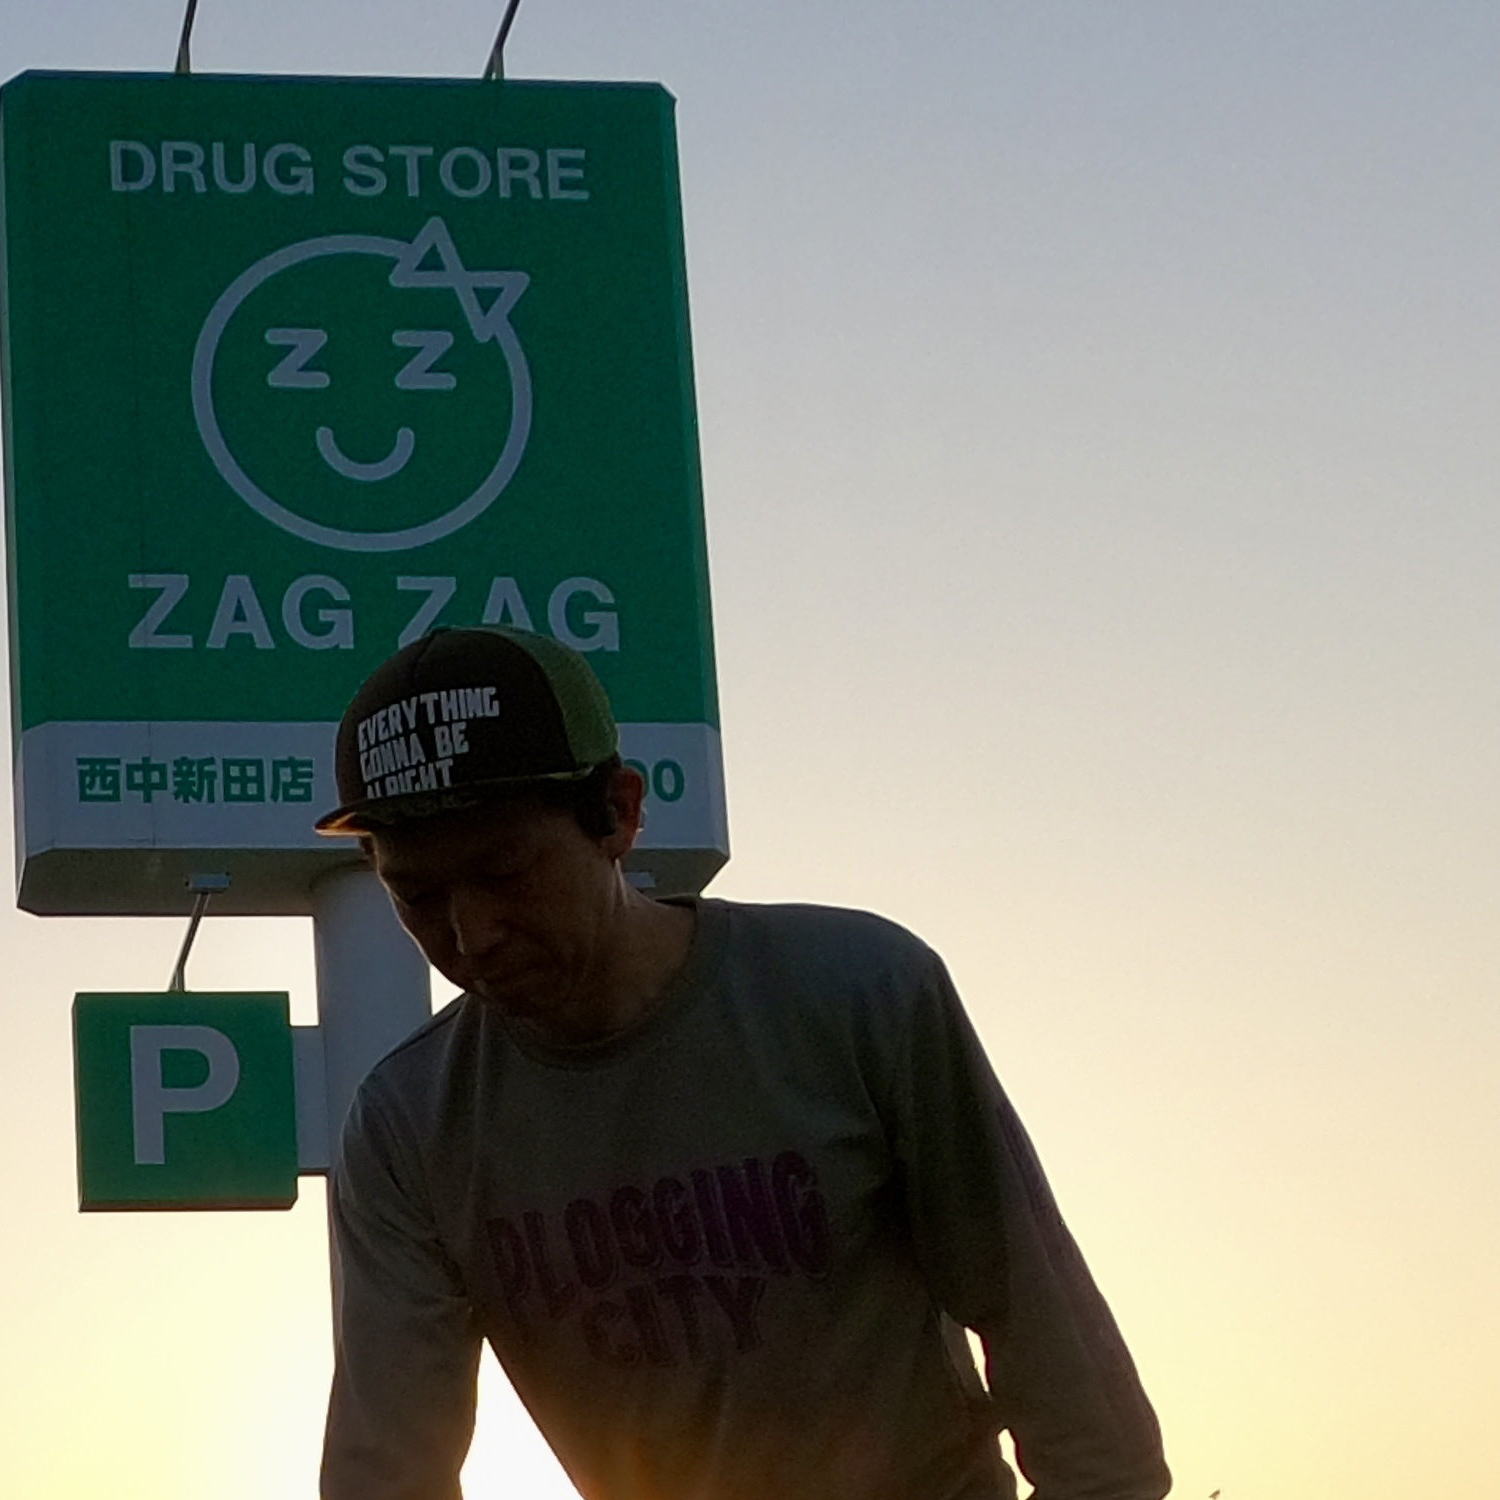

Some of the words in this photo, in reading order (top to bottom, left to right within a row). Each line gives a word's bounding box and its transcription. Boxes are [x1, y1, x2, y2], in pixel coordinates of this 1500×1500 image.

[109, 139, 315, 196] DRUG
[341, 144, 590, 200] STORE
[127, 574, 355, 650] ZAG
[396, 576, 620, 652] ZAG
[358, 686, 500, 751] EVERYTHING
[76, 756, 314, 803] 西中新田店
[360, 732, 426, 783] GONNA
[434, 721, 470, 758] BE
[129, 1024, 241, 1165] P
